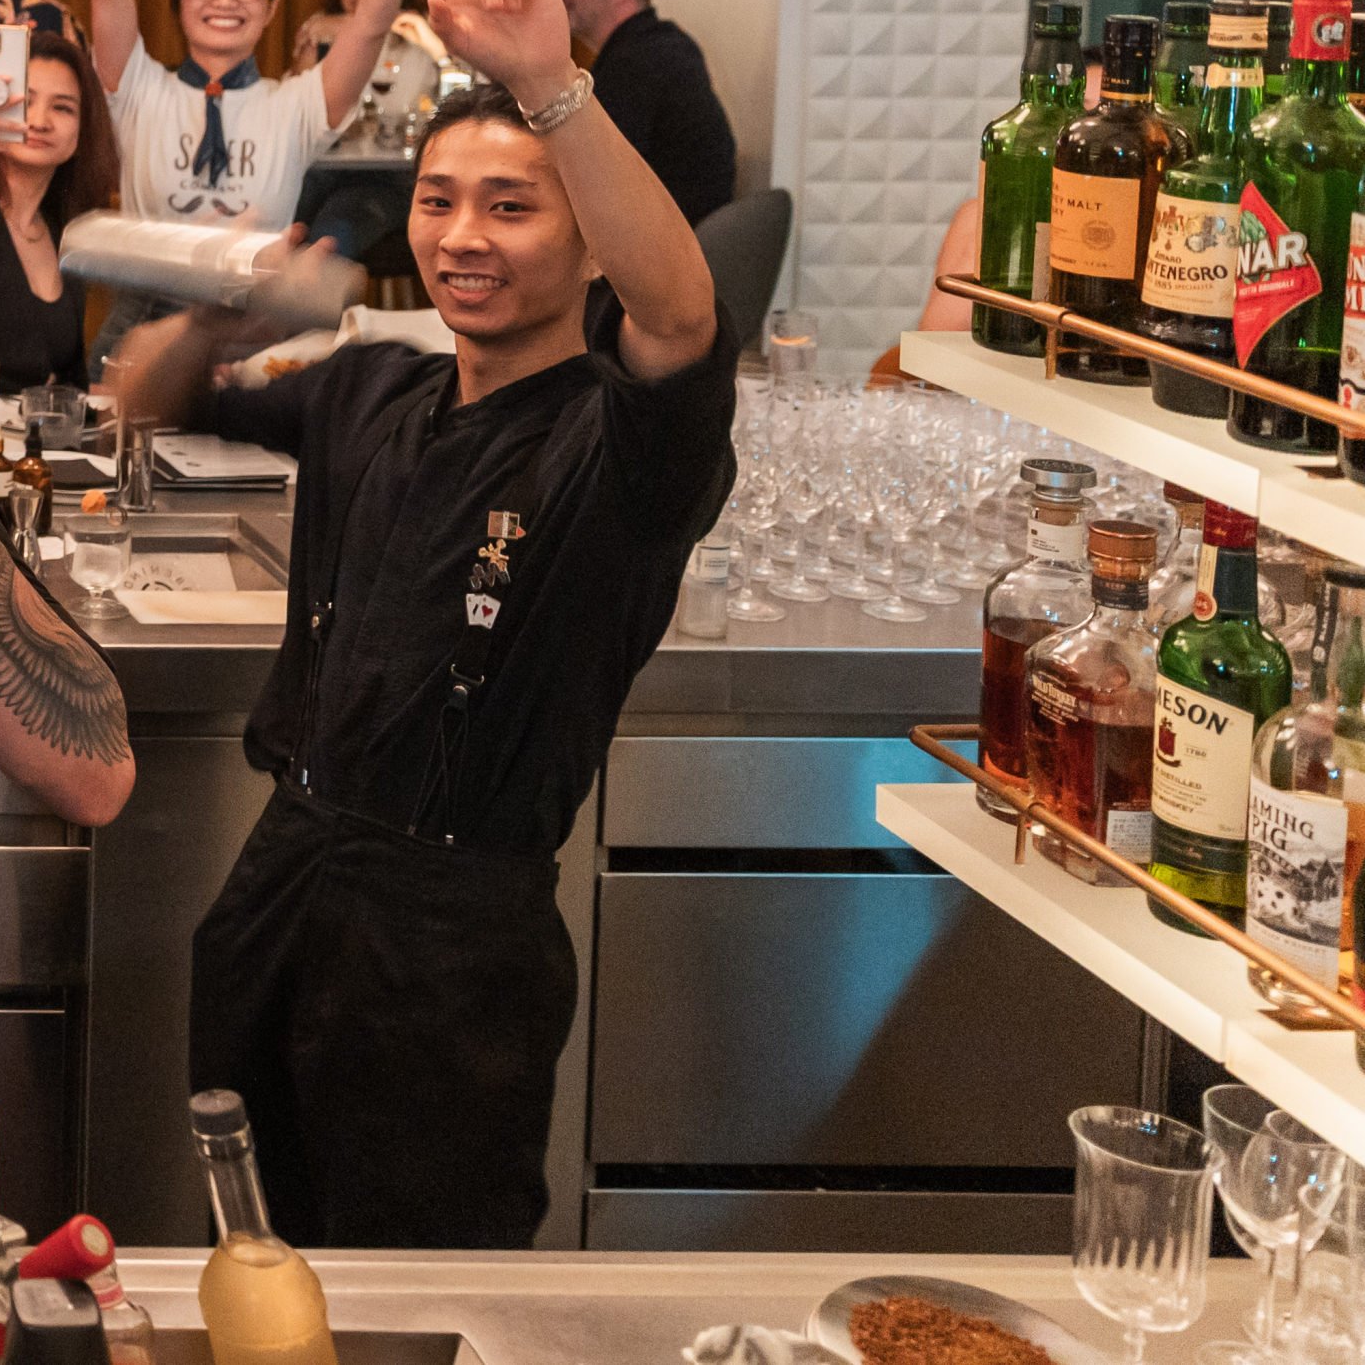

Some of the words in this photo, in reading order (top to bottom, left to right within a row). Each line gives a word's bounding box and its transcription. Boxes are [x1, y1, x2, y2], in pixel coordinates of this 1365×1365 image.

[174, 133, 256, 177] SER
[1067, 198, 1103, 212] MALT
[1156, 686, 1230, 736] ESON
